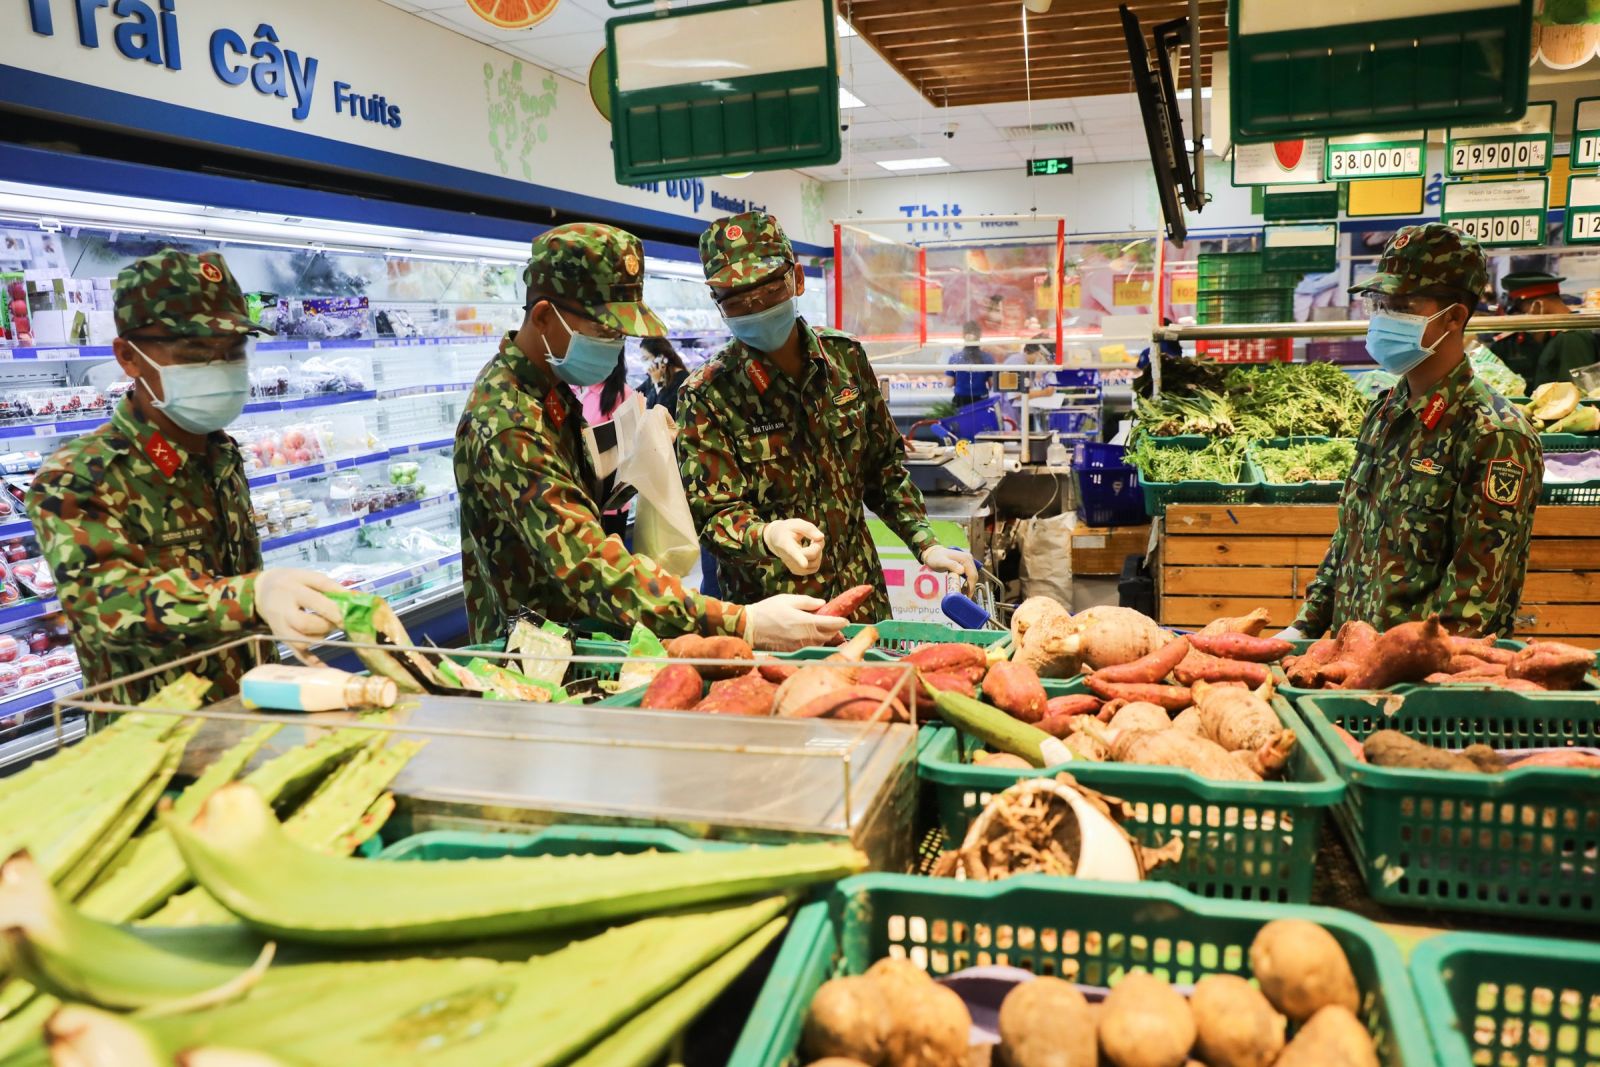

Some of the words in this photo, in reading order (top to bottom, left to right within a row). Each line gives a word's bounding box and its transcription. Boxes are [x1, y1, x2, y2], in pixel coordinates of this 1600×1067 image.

[209, 23, 319, 120] cây
[333, 80, 402, 129] Fruits
[1334, 152, 1402, 170] 38.000
[1456, 145, 1528, 166] 29.900
